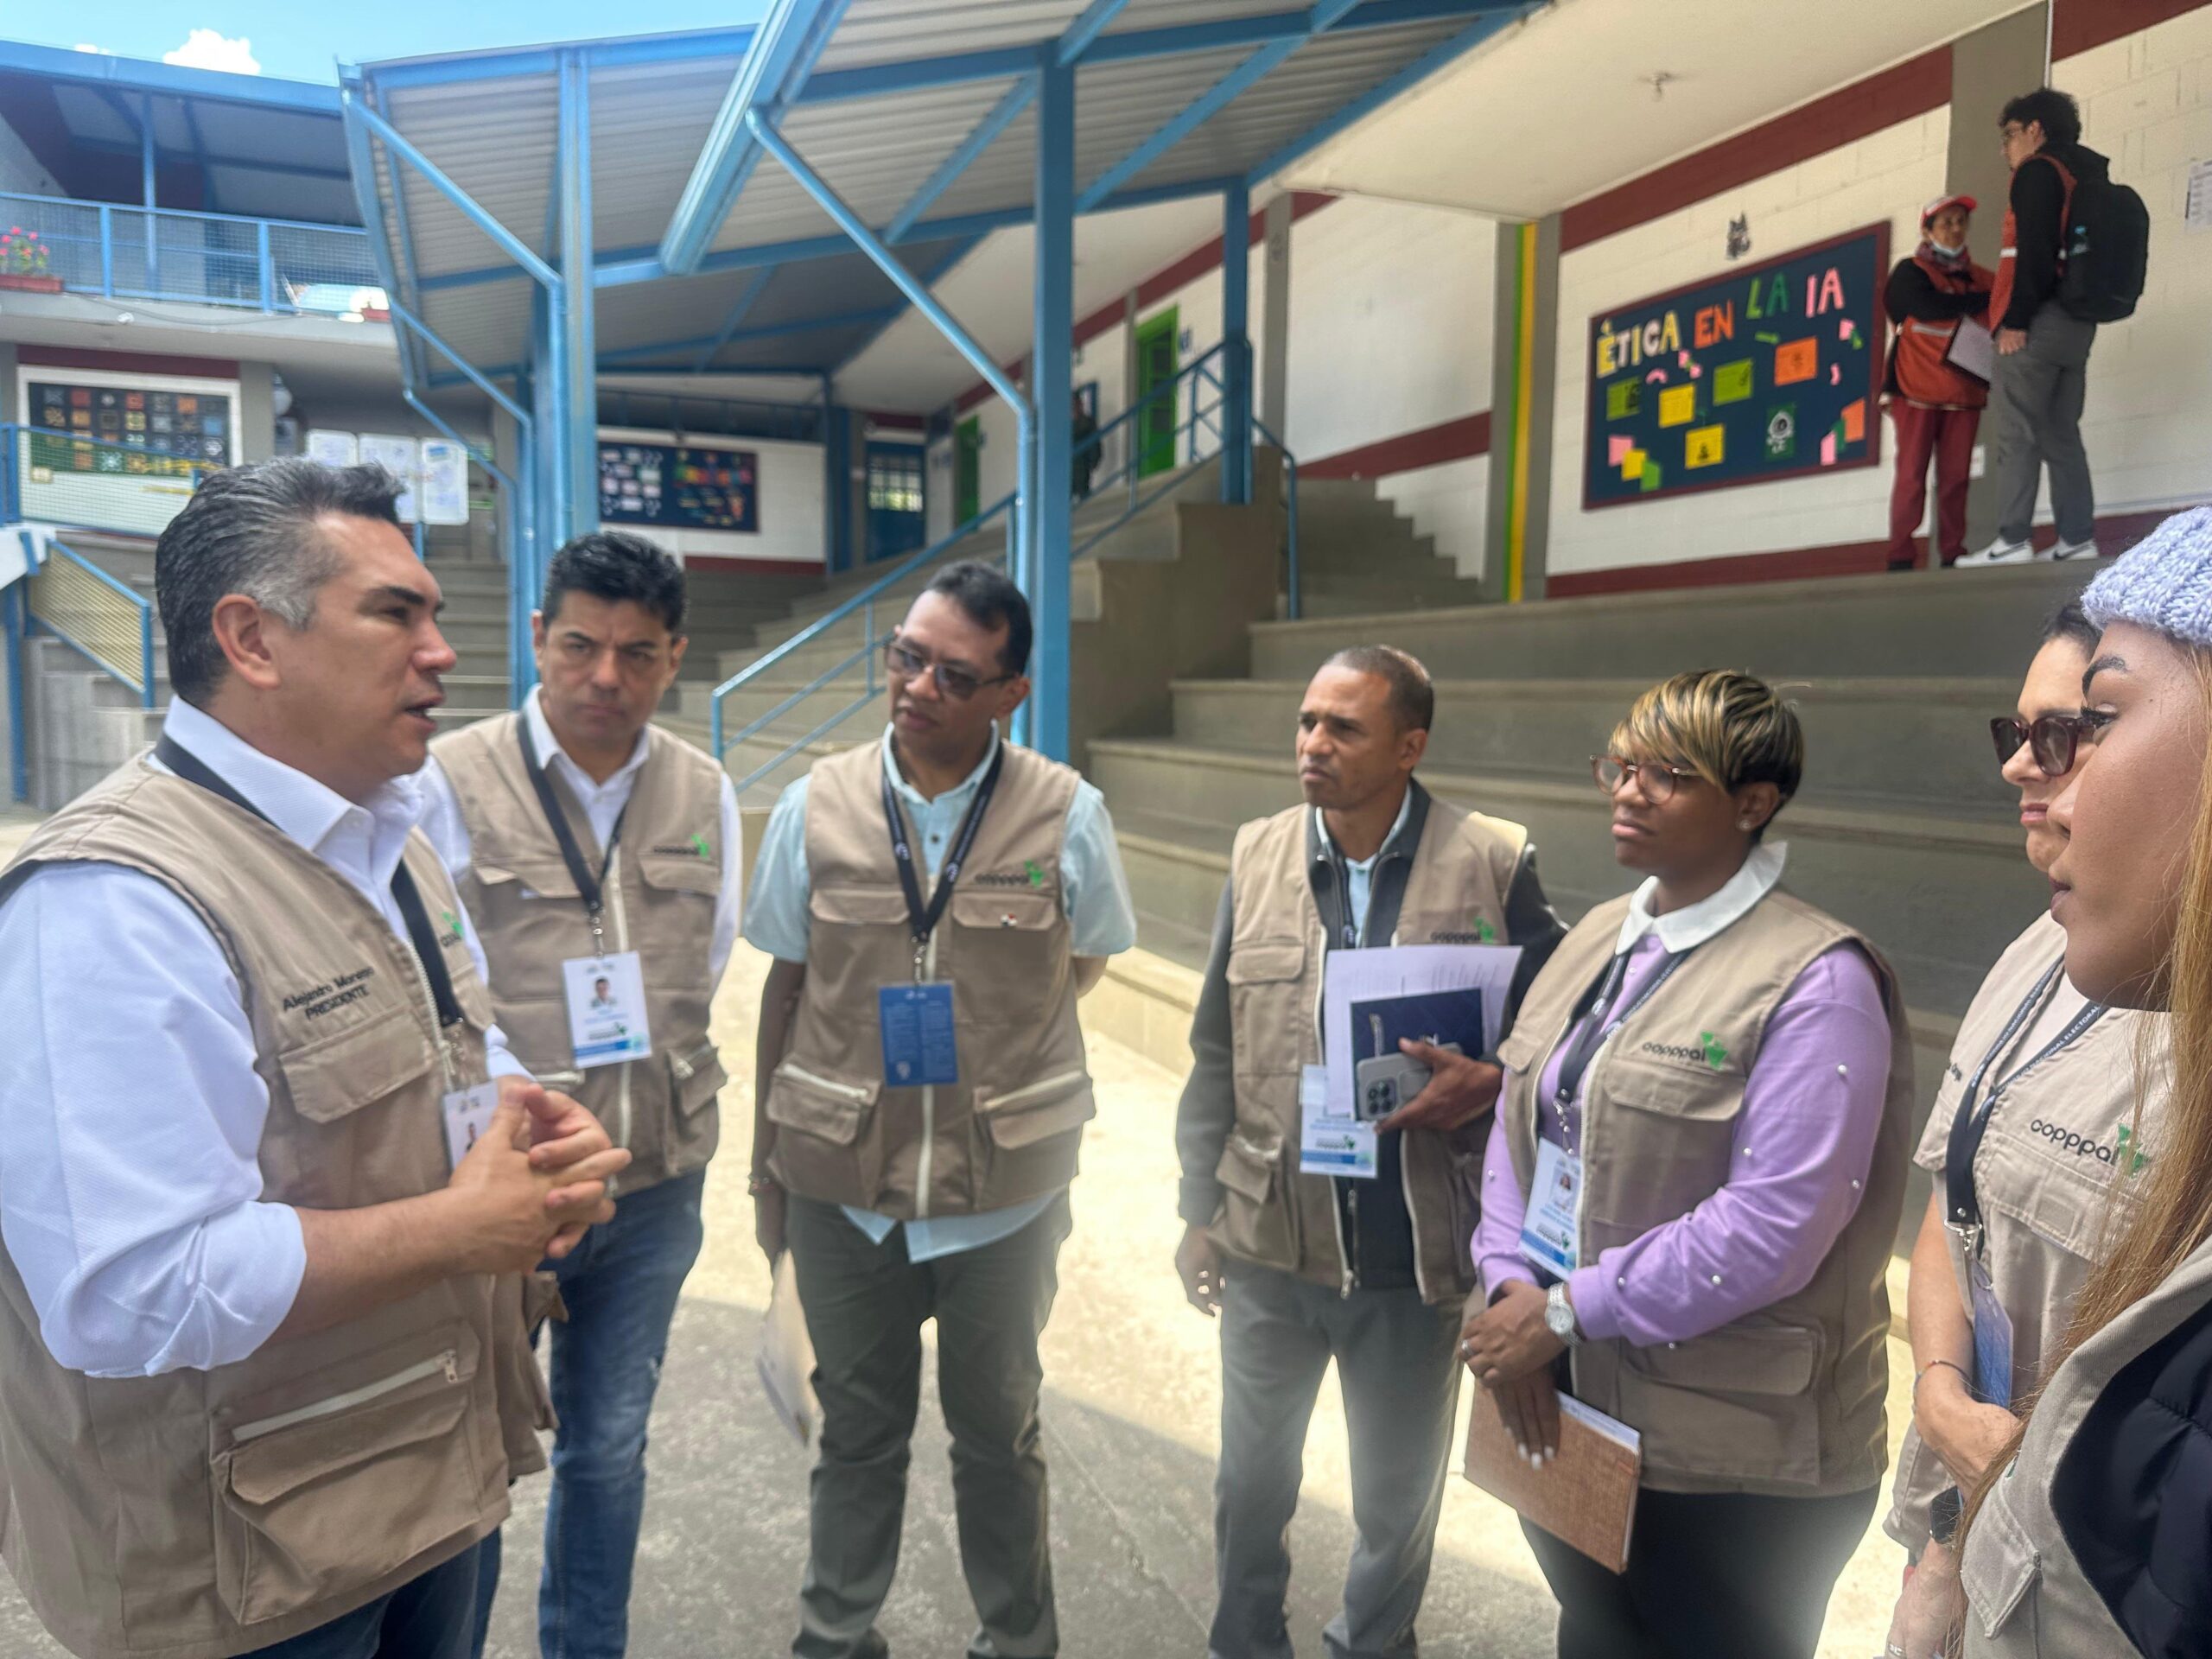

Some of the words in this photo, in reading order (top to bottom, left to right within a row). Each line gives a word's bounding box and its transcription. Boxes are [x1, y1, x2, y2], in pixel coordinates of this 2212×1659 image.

[1597, 309, 1681, 378] ÉTICA
[1694, 298, 1734, 349] EN
[1745, 272, 1789, 319] LA
[1805, 266, 1845, 318] IA
[305, 983, 371, 1021] PRESIDENTE
[2063, 1005, 2101, 1042] ELECTORAL
[2030, 1119, 2120, 1166] copppal
